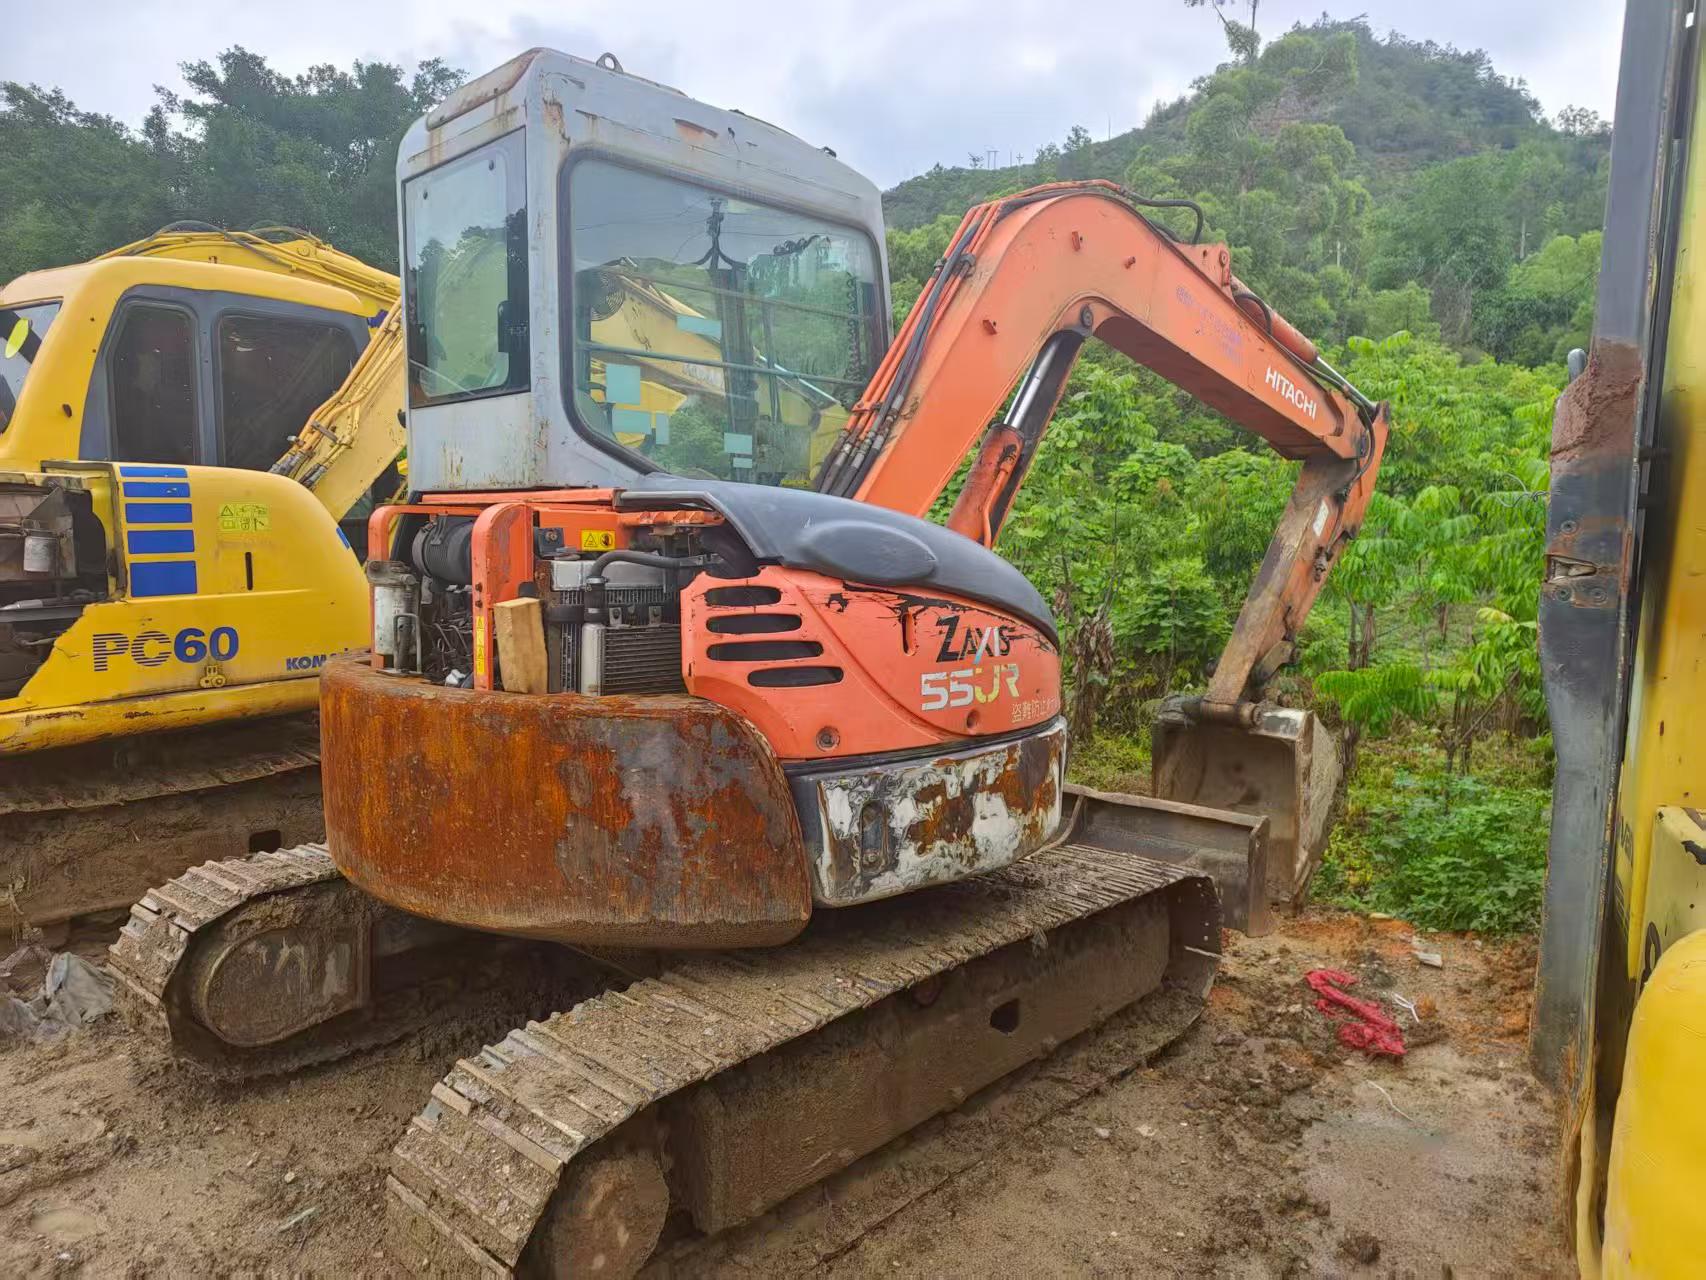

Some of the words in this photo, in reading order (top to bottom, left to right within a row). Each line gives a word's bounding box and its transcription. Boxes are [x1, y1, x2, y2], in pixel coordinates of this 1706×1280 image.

[1265, 366, 1317, 422] HITACHI
[92, 626, 239, 672] PC60
[286, 653, 337, 671] KOM
[936, 615, 1011, 665] ZAXIS
